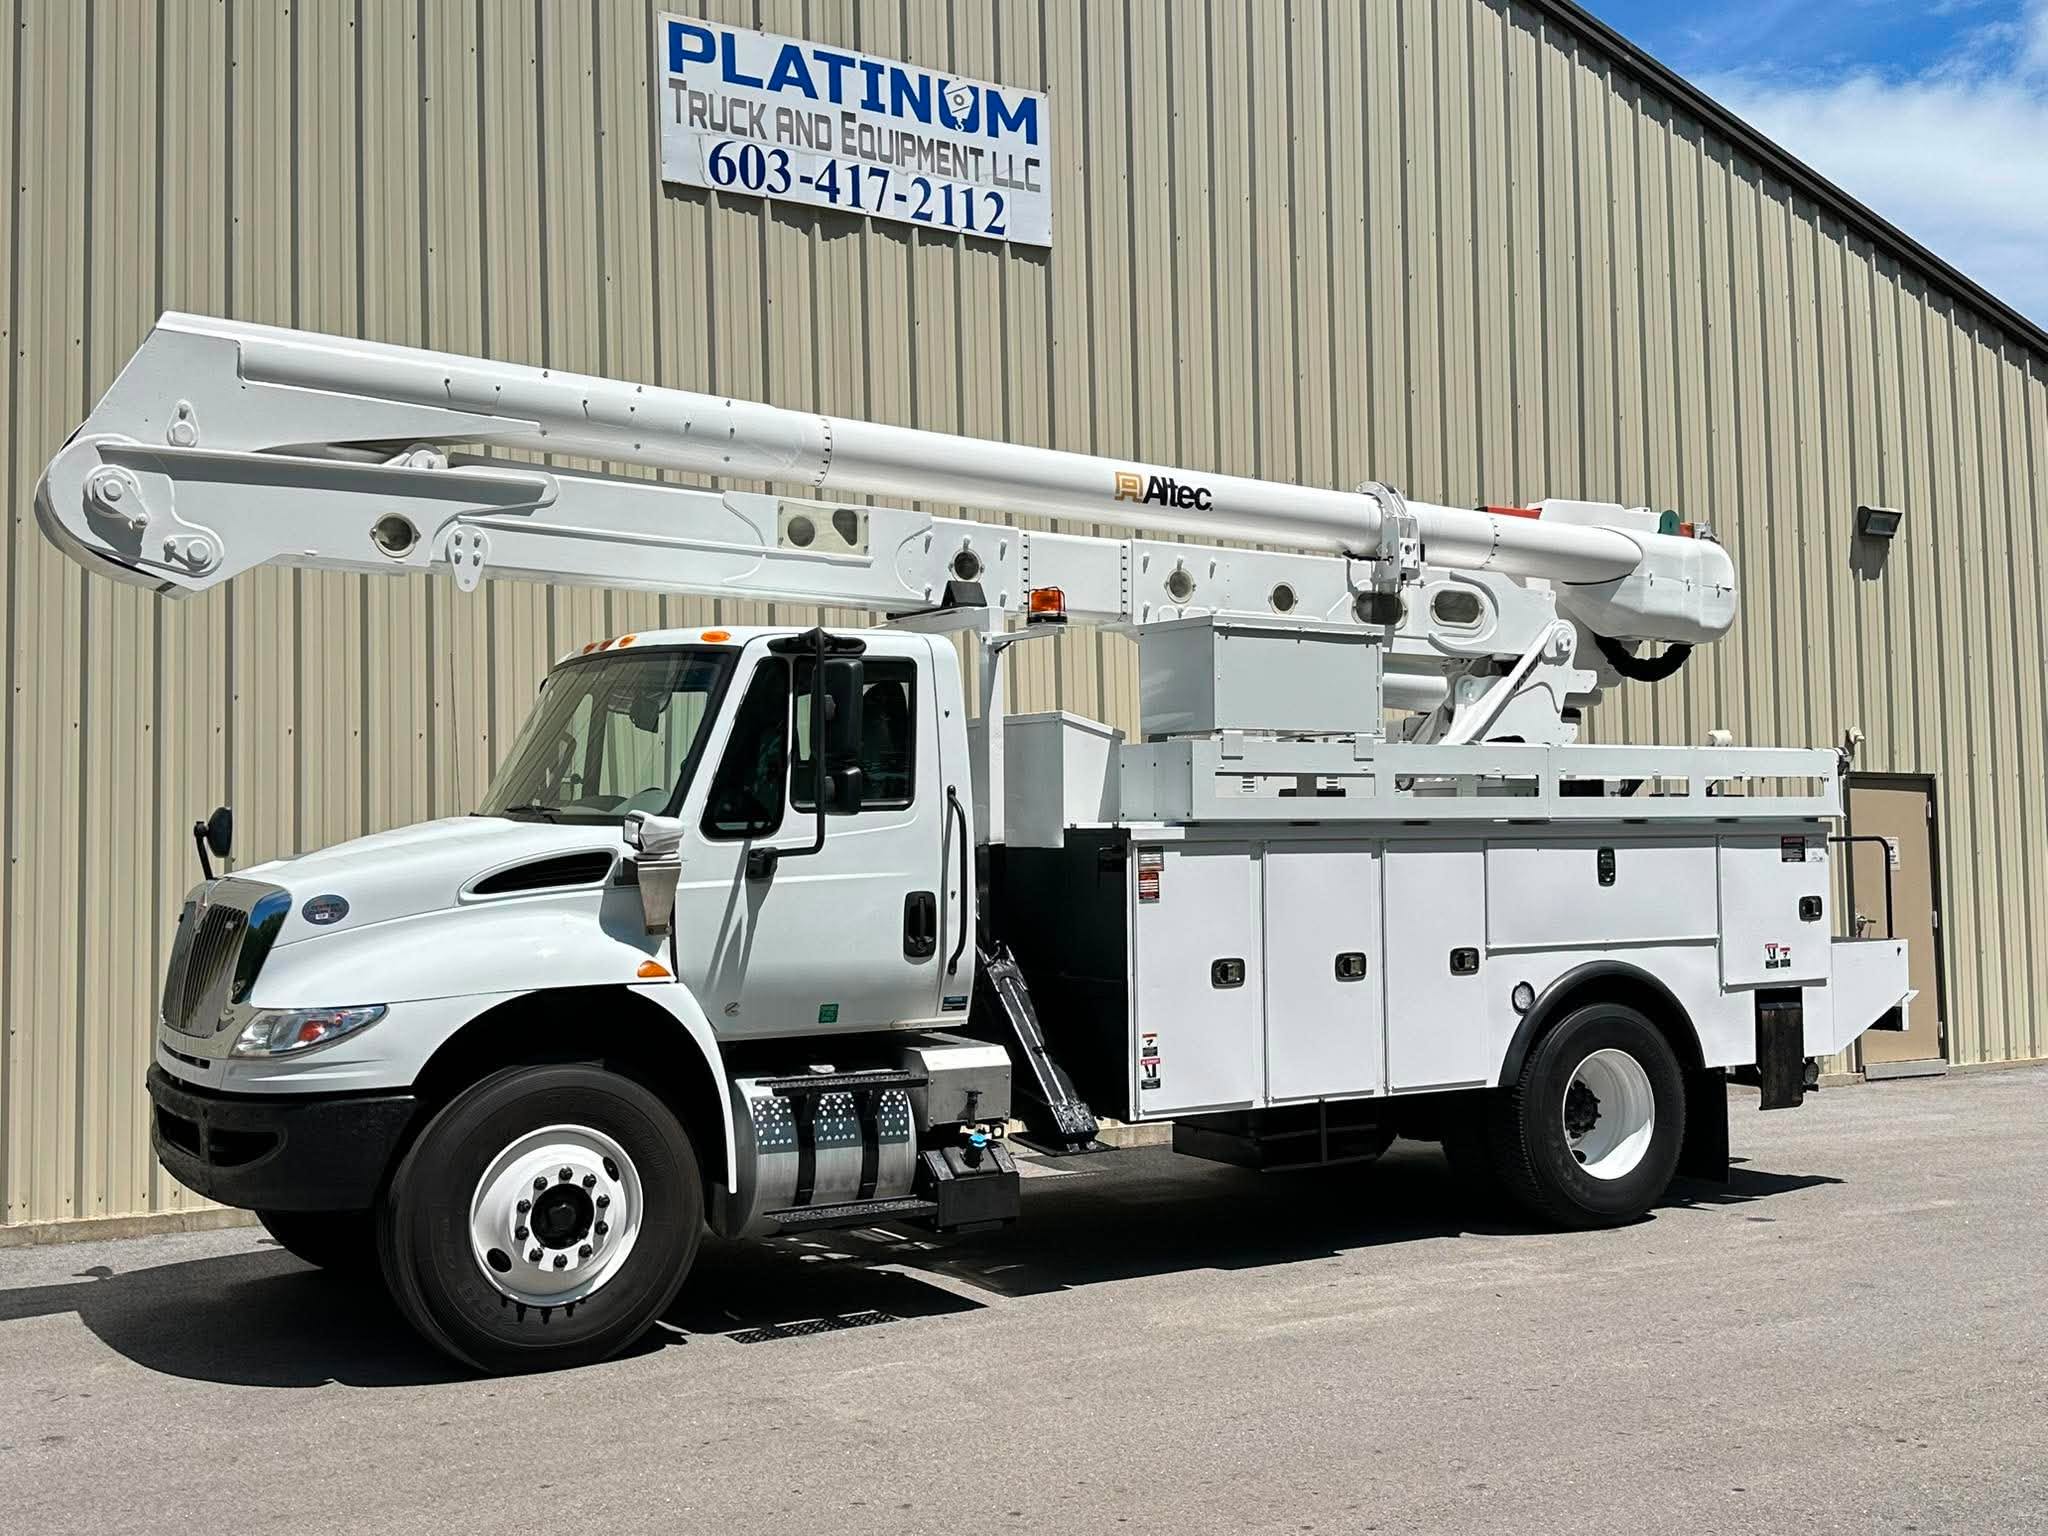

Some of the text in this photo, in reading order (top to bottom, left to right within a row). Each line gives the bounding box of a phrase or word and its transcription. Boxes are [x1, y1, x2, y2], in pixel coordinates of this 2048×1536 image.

[668, 20, 1038, 146] PLATINUM
[668, 77, 1041, 193] TRUCK AND EQUIPMENT LLC
[708, 140, 1006, 236] 603-417-2112
